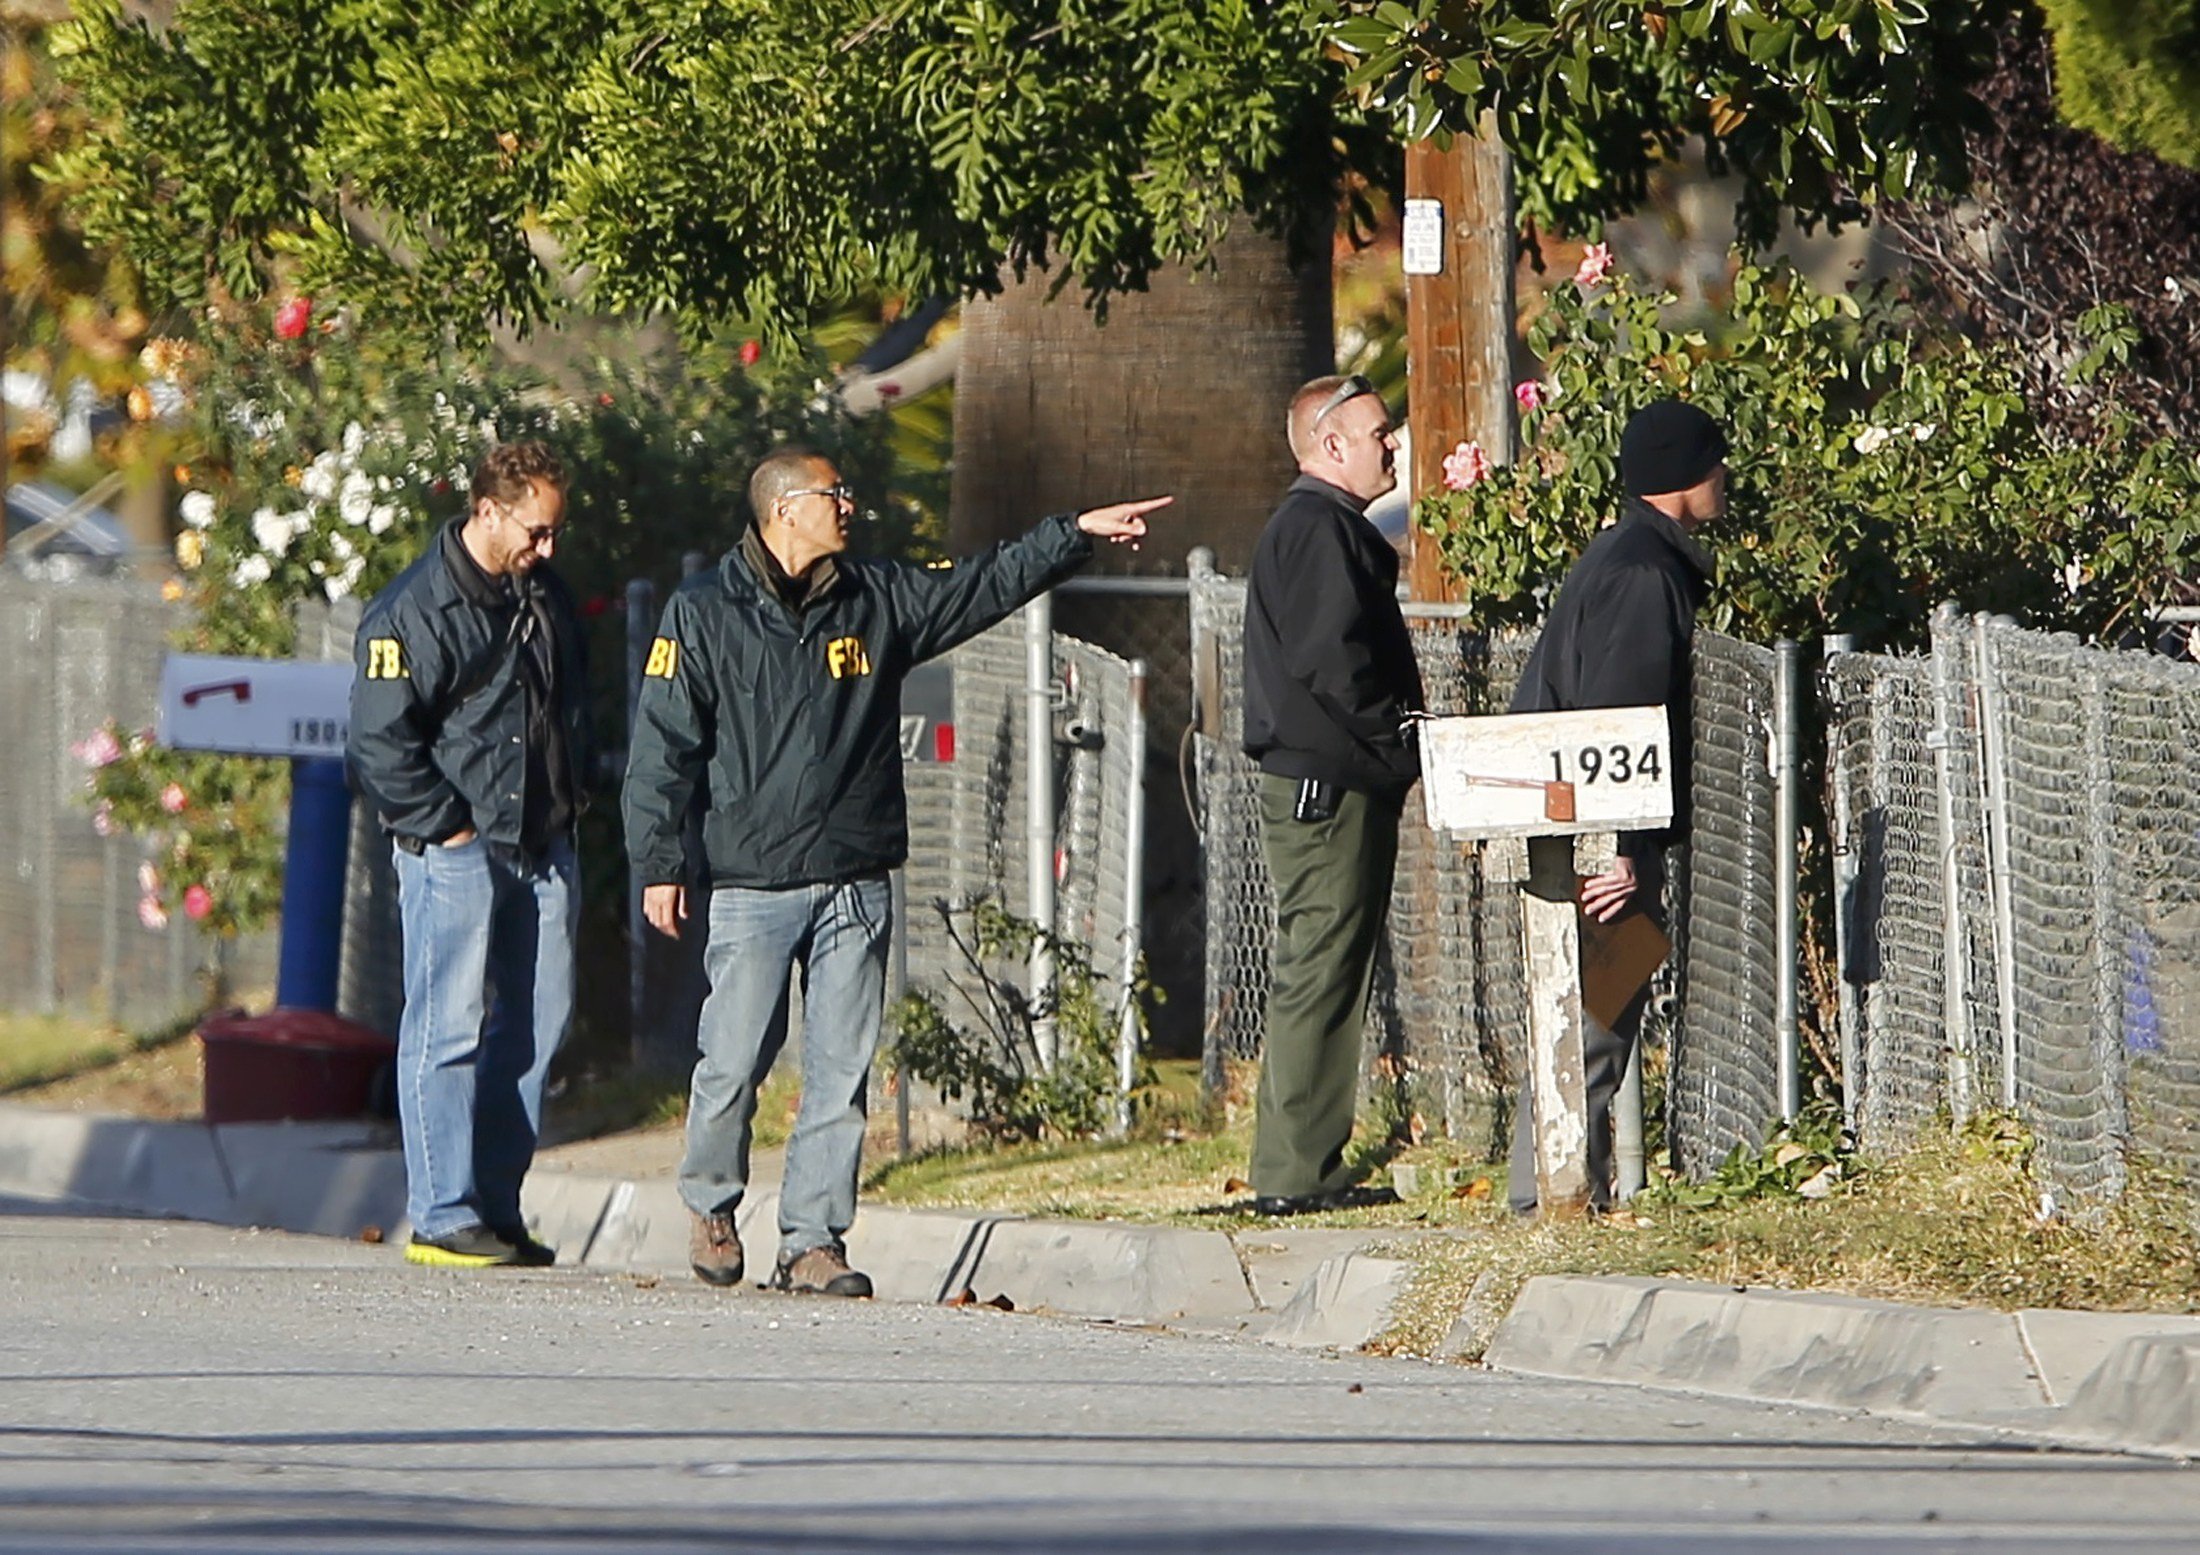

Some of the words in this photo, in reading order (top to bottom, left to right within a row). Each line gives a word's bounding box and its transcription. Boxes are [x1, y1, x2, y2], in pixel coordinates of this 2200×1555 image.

[367, 638, 410, 679] FB
[828, 637, 870, 679] FBI
[1550, 744, 1662, 785] 1934
